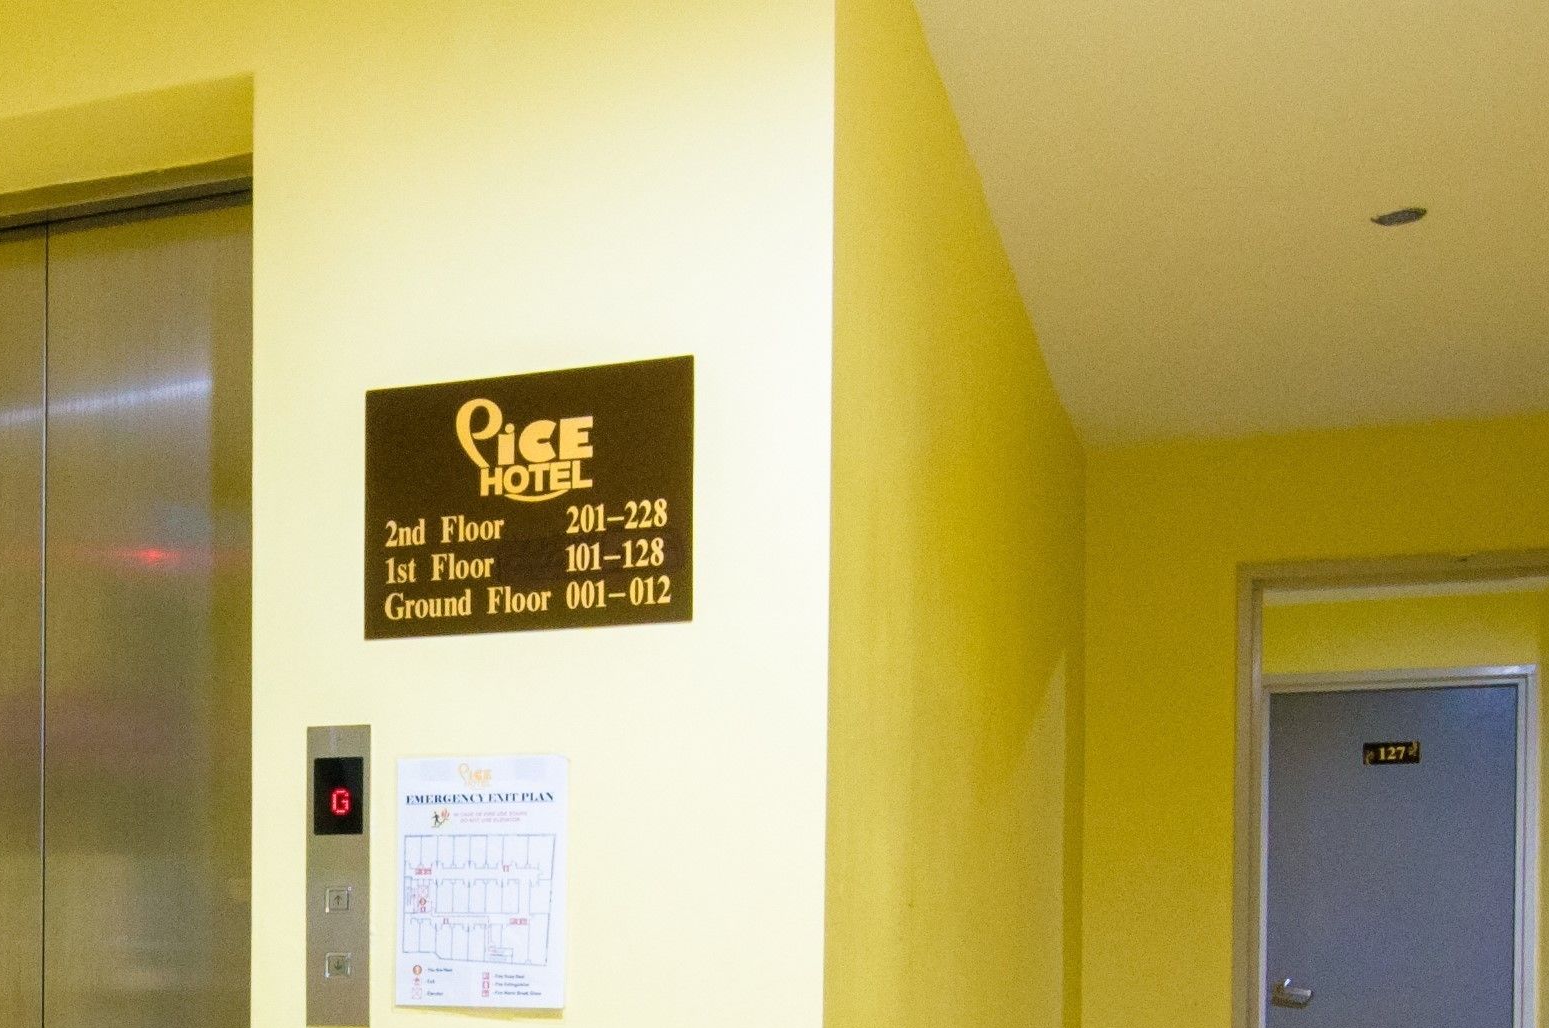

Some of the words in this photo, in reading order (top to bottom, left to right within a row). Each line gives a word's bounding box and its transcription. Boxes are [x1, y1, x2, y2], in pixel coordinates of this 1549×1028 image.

[480, 460, 593, 497] HOTEL
[385, 518, 426, 548] 2nd
[440, 514, 505, 543] Floor
[566, 498, 668, 534] 201-228
[385, 557, 417, 584] 1st
[431, 553, 494, 581] Floor
[565, 537, 665, 572] 101-128
[384, 588, 472, 621] Ground
[486, 585, 551, 615] Floor
[565, 575, 671, 610] 001-012
[1379, 746, 1406, 761] 127
[331, 788, 350, 815] G
[406, 794, 484, 804] EMERGENCY
[488, 793, 518, 802] EXIT
[521, 792, 555, 802] PLAN
